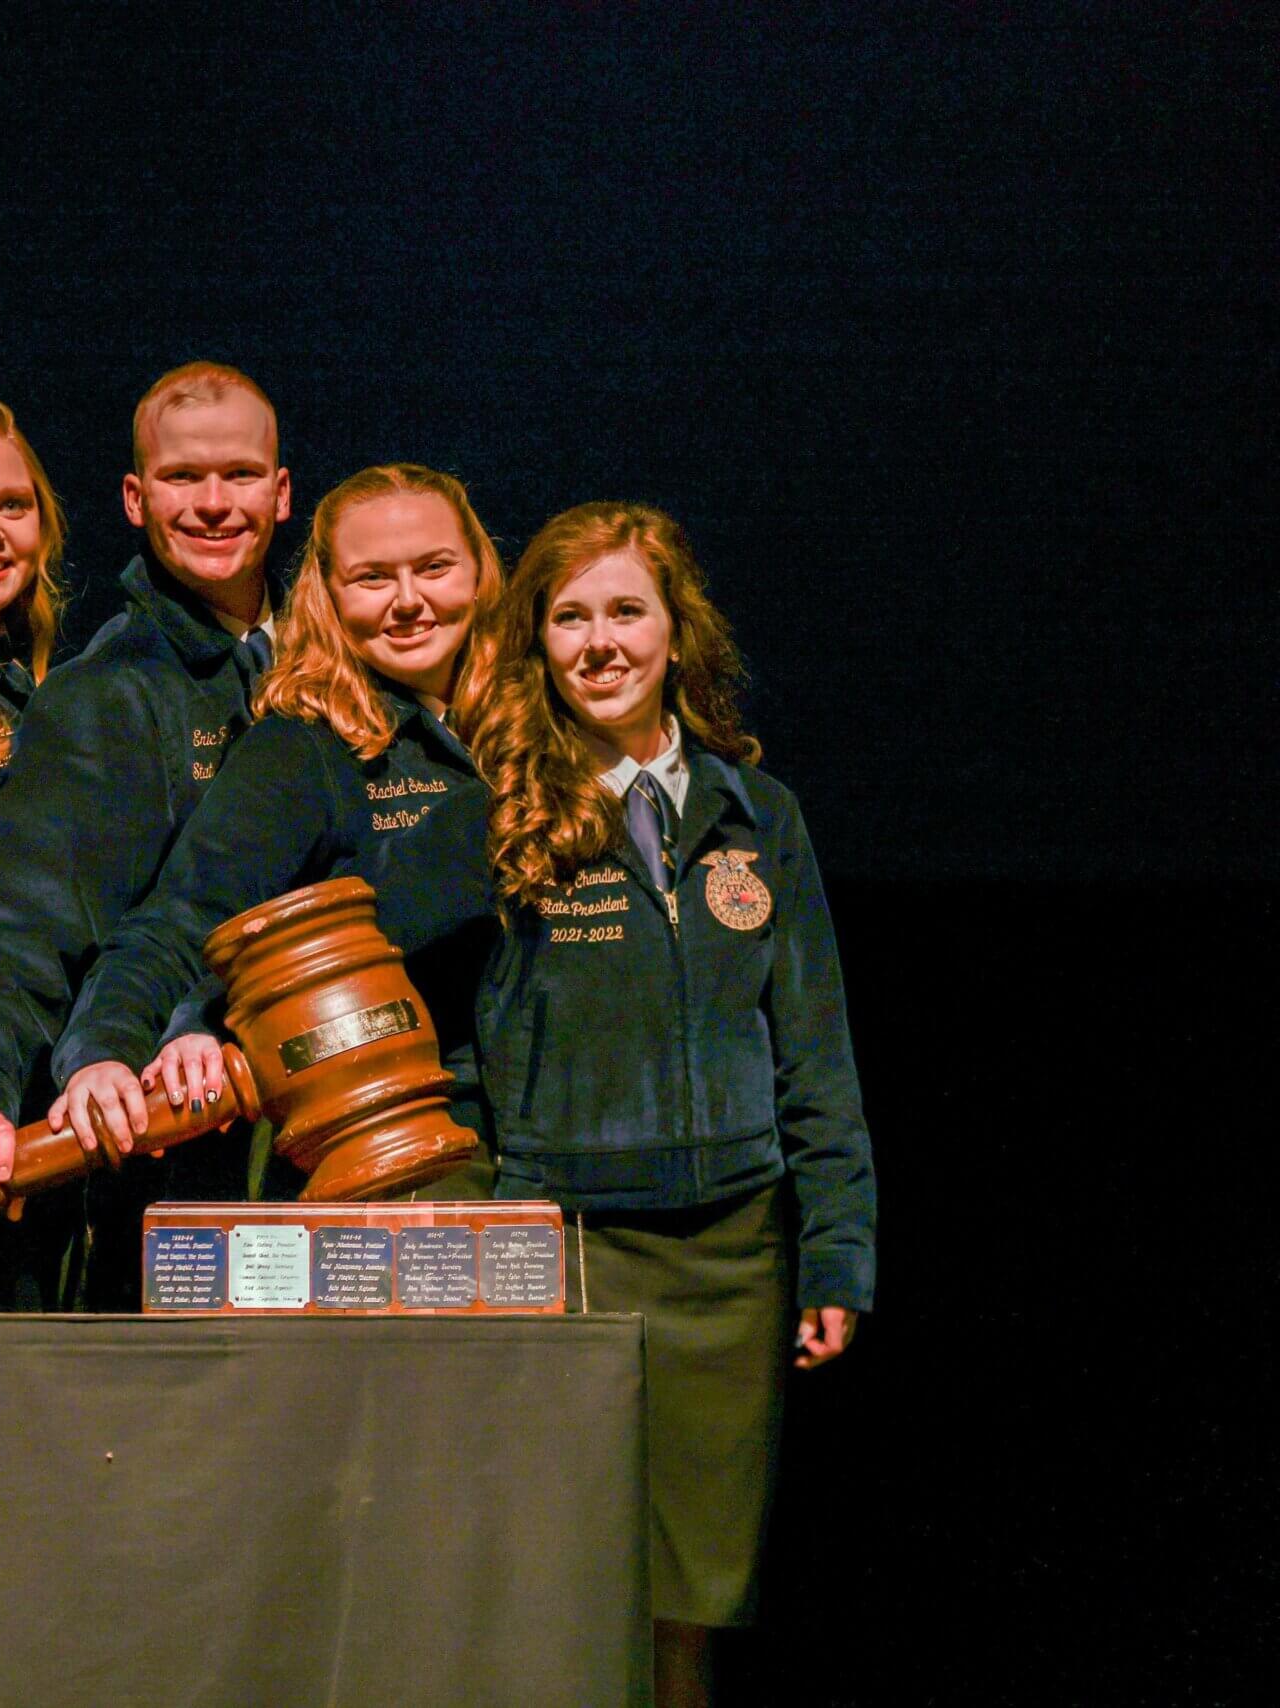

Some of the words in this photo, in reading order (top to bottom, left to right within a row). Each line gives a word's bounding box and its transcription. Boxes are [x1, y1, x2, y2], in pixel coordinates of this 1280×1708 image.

[193, 729, 217, 747] Eric
[193, 762, 215, 780] Stat
[366, 777, 408, 800] Rachel
[372, 812, 400, 831] State
[396, 810, 420, 828] Vice
[574, 866, 627, 889] Chandler
[539, 897, 571, 915] State
[570, 894, 629, 917] President
[550, 924, 624, 943] 2021-2022
